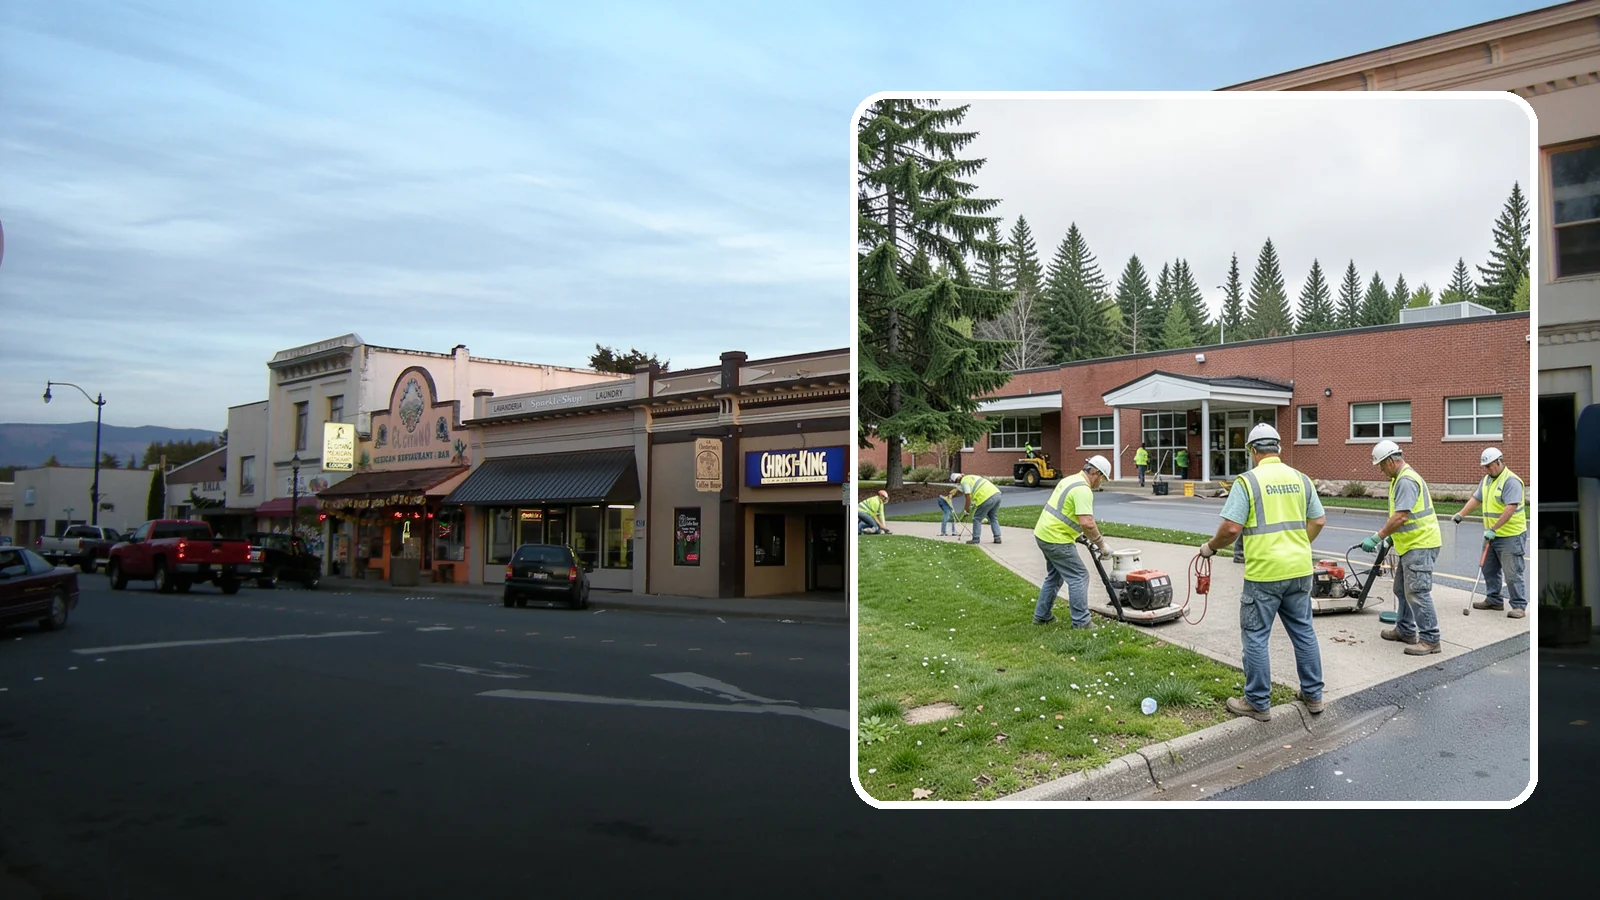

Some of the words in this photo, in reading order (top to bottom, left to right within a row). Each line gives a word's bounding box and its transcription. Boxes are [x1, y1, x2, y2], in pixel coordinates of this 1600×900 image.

[596, 389, 623, 399] LAUNDRY
[531, 398, 561, 408] Sparkle
[562, 395, 582, 405] Shop
[493, 402, 523, 413] LAVANDERIA
[374, 456, 396, 464] MEXICAN
[397, 452, 433, 462] RESTAURANT
[438, 450, 450, 459] BAR
[697, 481, 709, 489] Coffee
